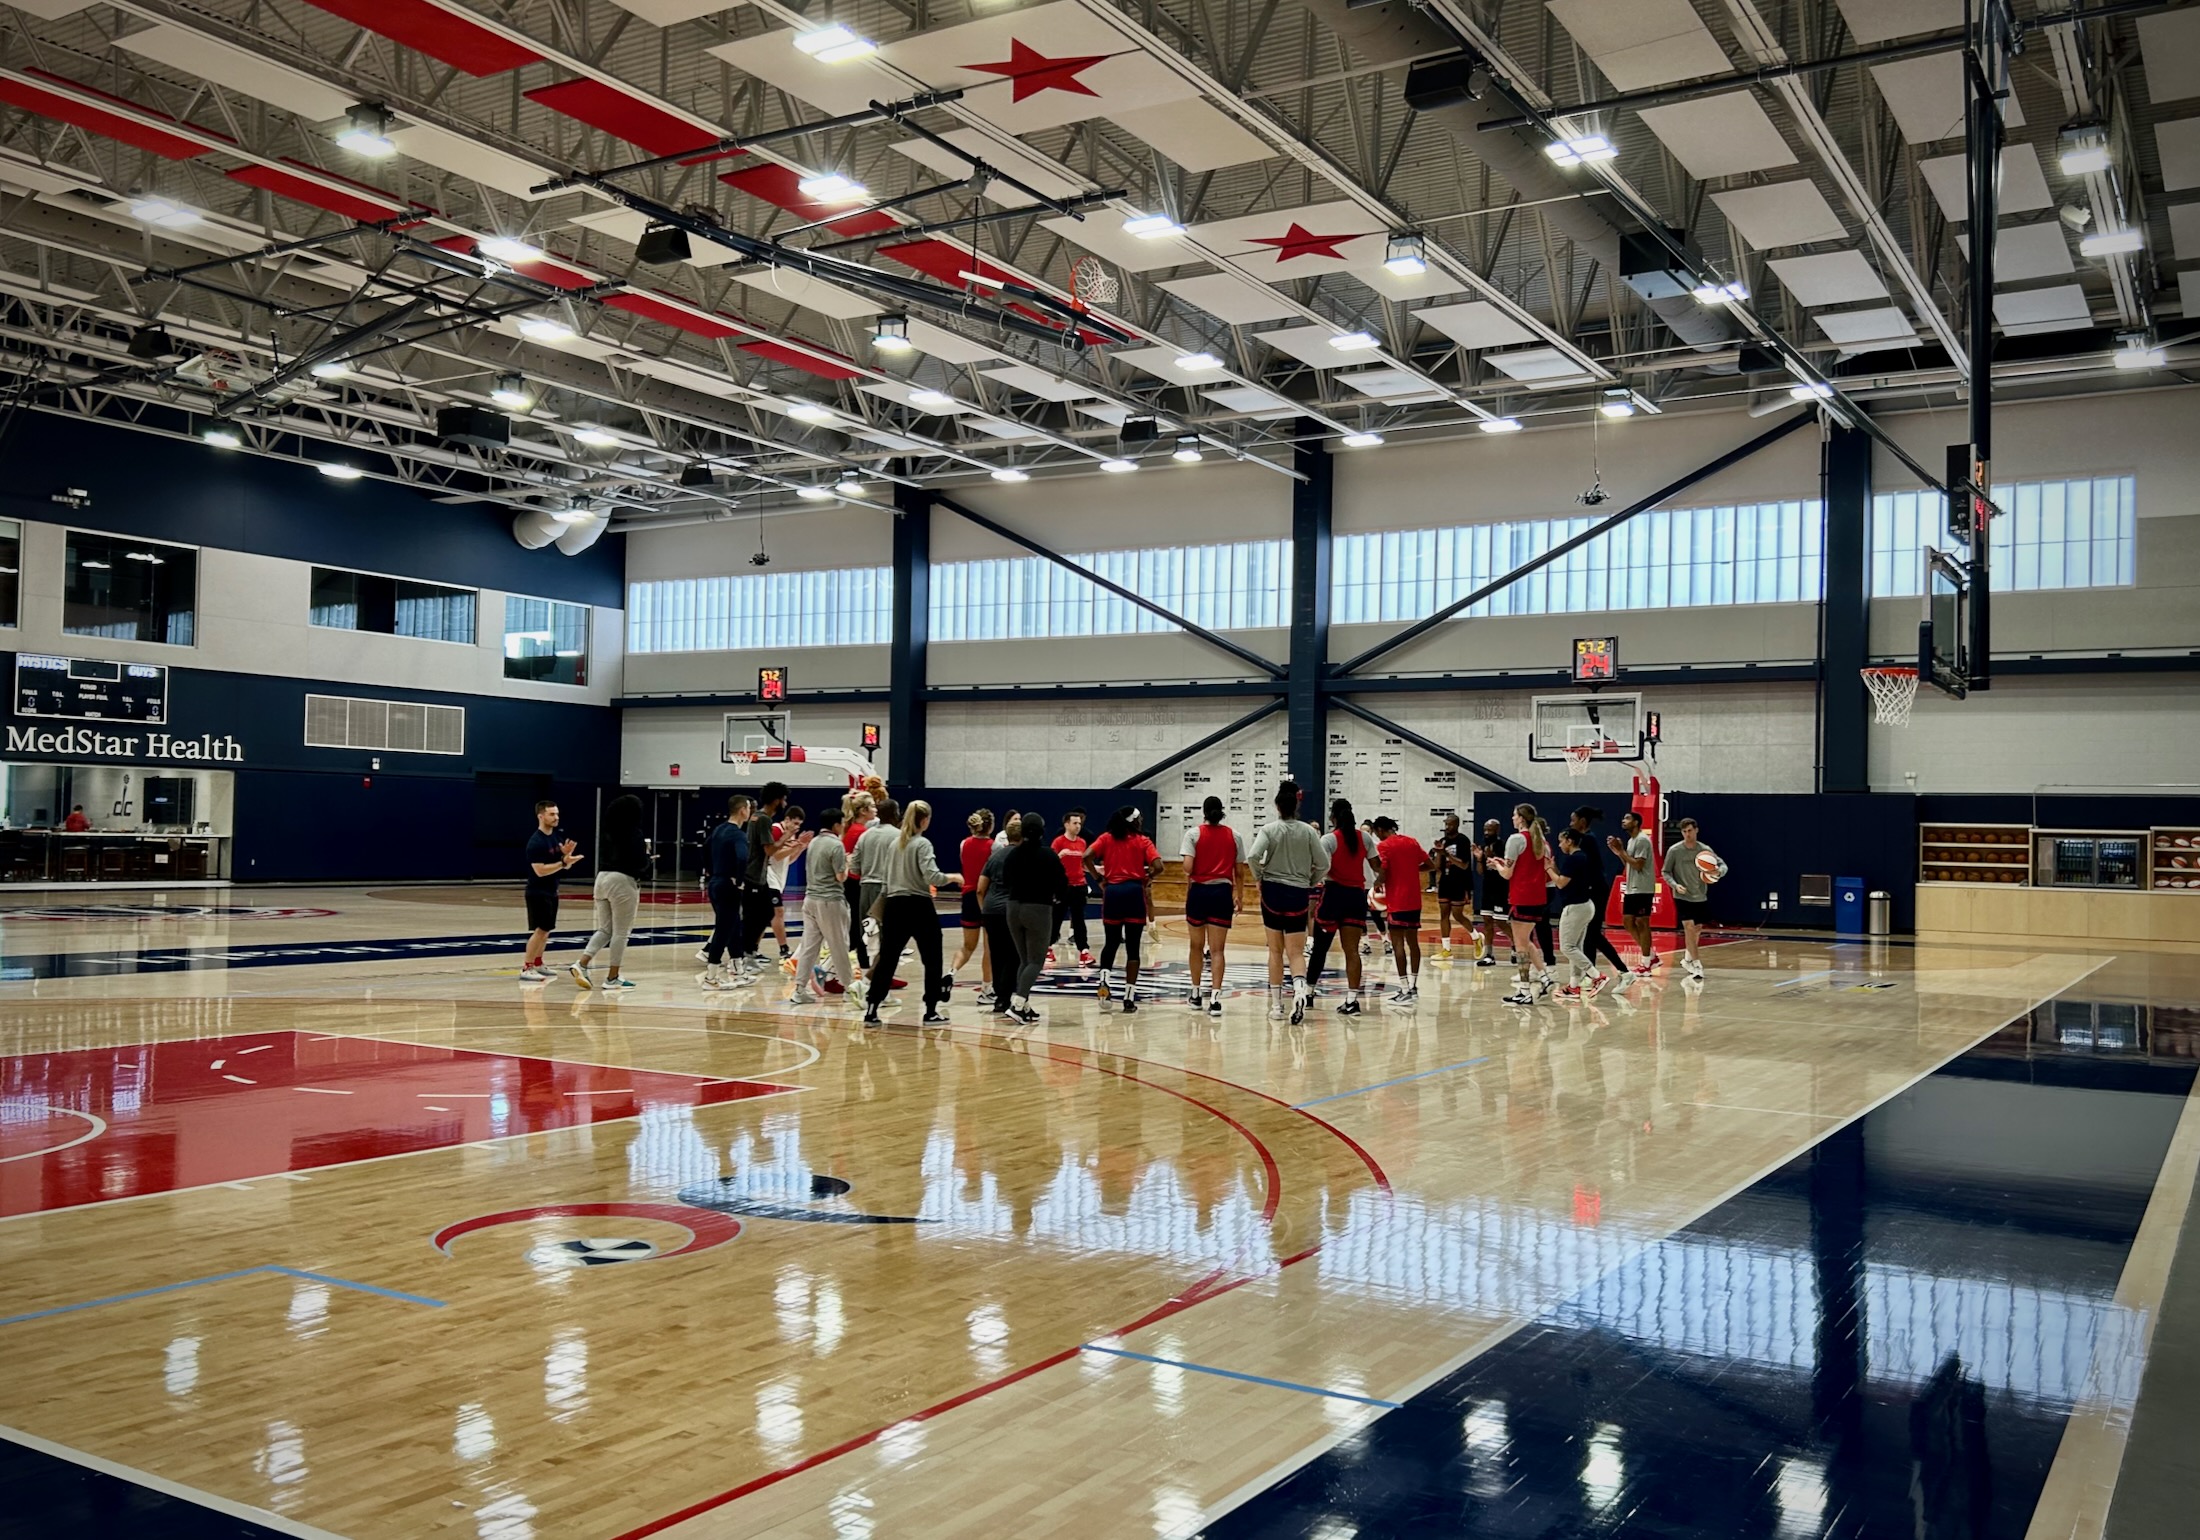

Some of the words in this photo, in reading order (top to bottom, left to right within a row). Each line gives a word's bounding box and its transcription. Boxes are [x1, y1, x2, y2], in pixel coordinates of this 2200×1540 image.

[1578, 641, 1605, 655] 57.2
[18, 655, 68, 671] MYSTICS
[1581, 654, 1609, 677] 24
[128, 665, 158, 678] GUYS
[1095, 712, 1135, 726] JOHNSON
[5, 726, 139, 757] MedStar
[146, 733, 244, 762] Health
